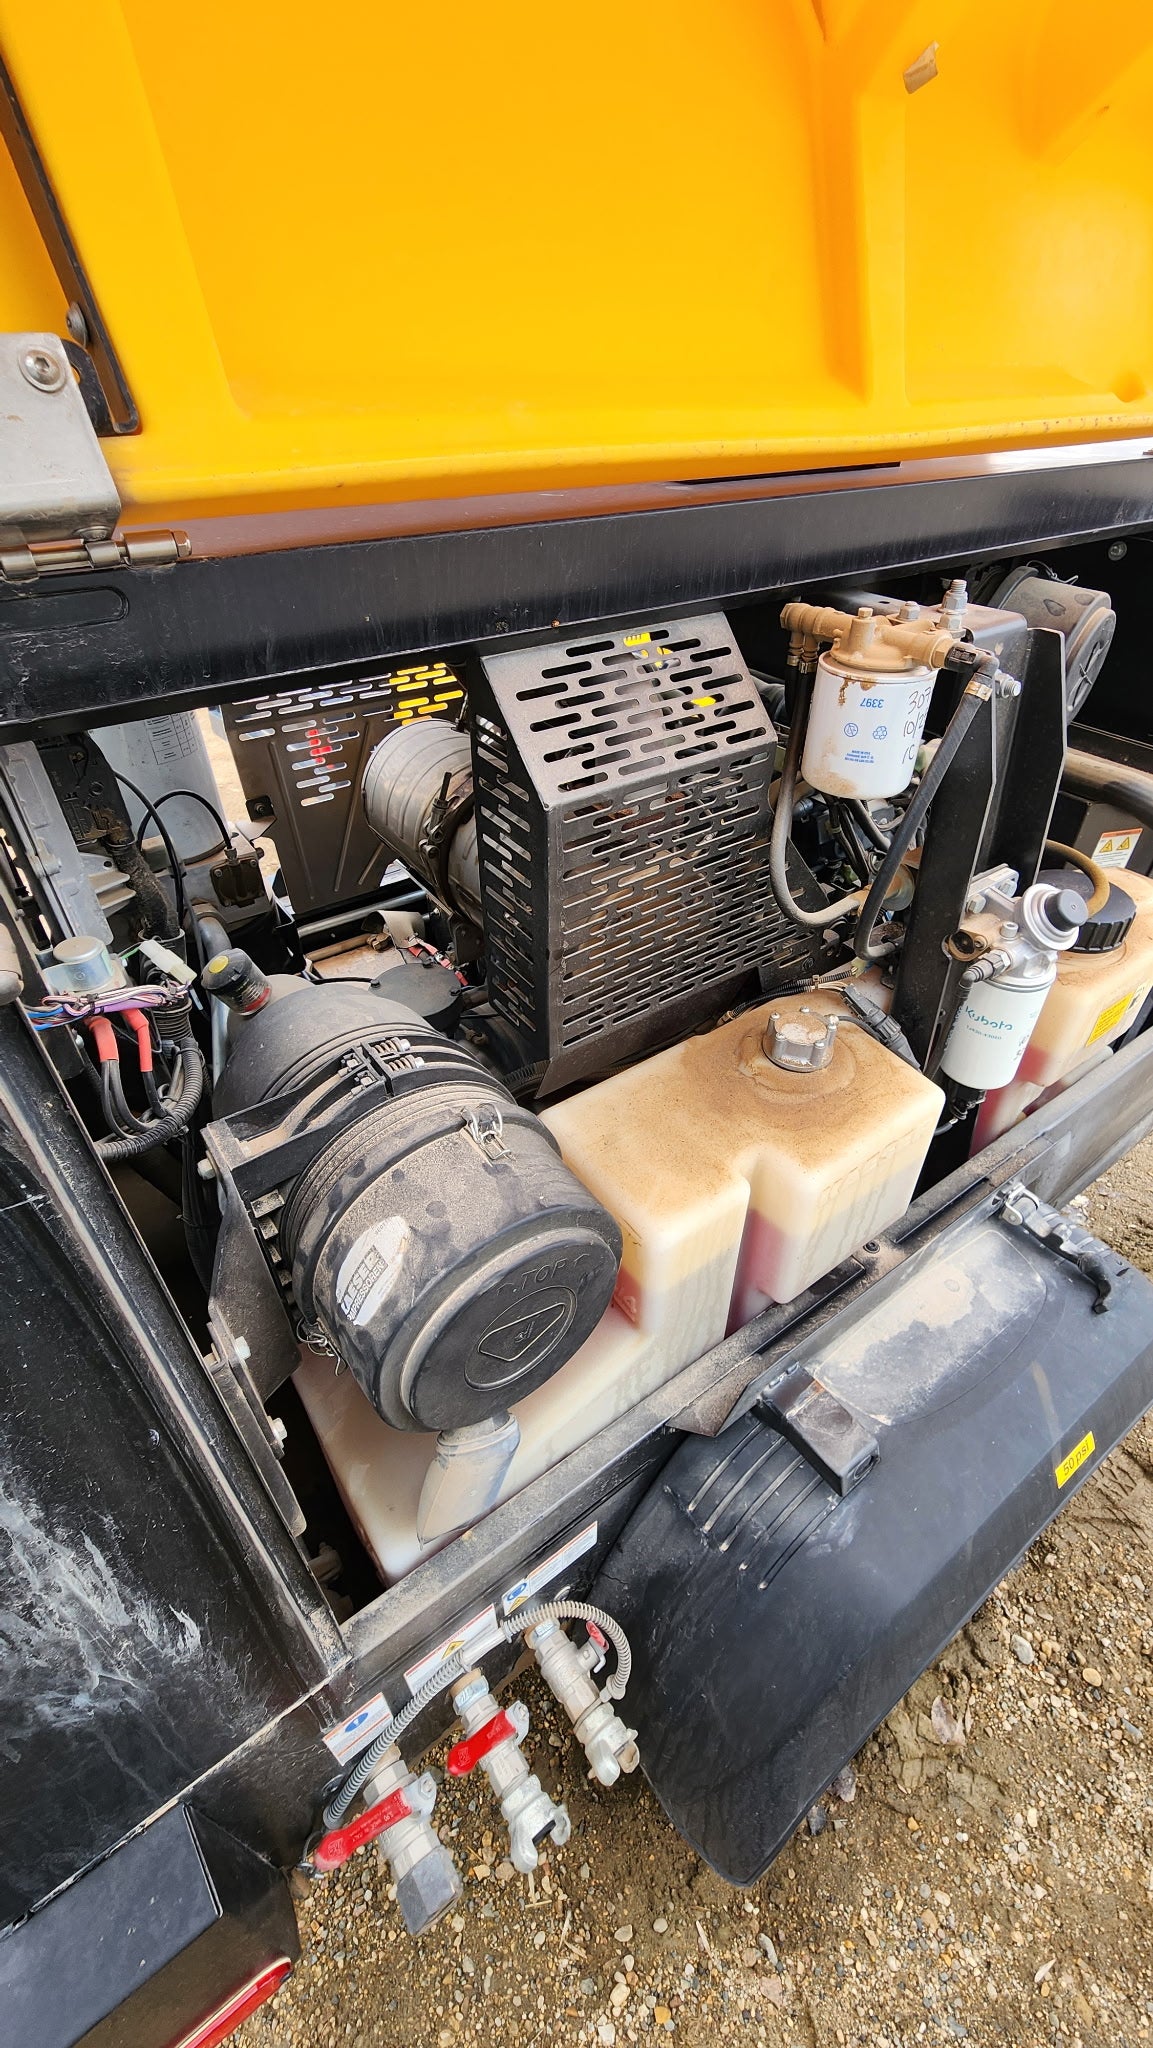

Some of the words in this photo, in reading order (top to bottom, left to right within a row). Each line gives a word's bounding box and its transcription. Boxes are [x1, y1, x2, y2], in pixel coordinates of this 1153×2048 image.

[860, 698, 884, 708] 3397
[965, 1006, 1013, 1030] Kubota
[520, 1258, 567, 1290] TOP
[1063, 1457, 1075, 1476] 50
[1075, 1440, 1090, 1466] psi
